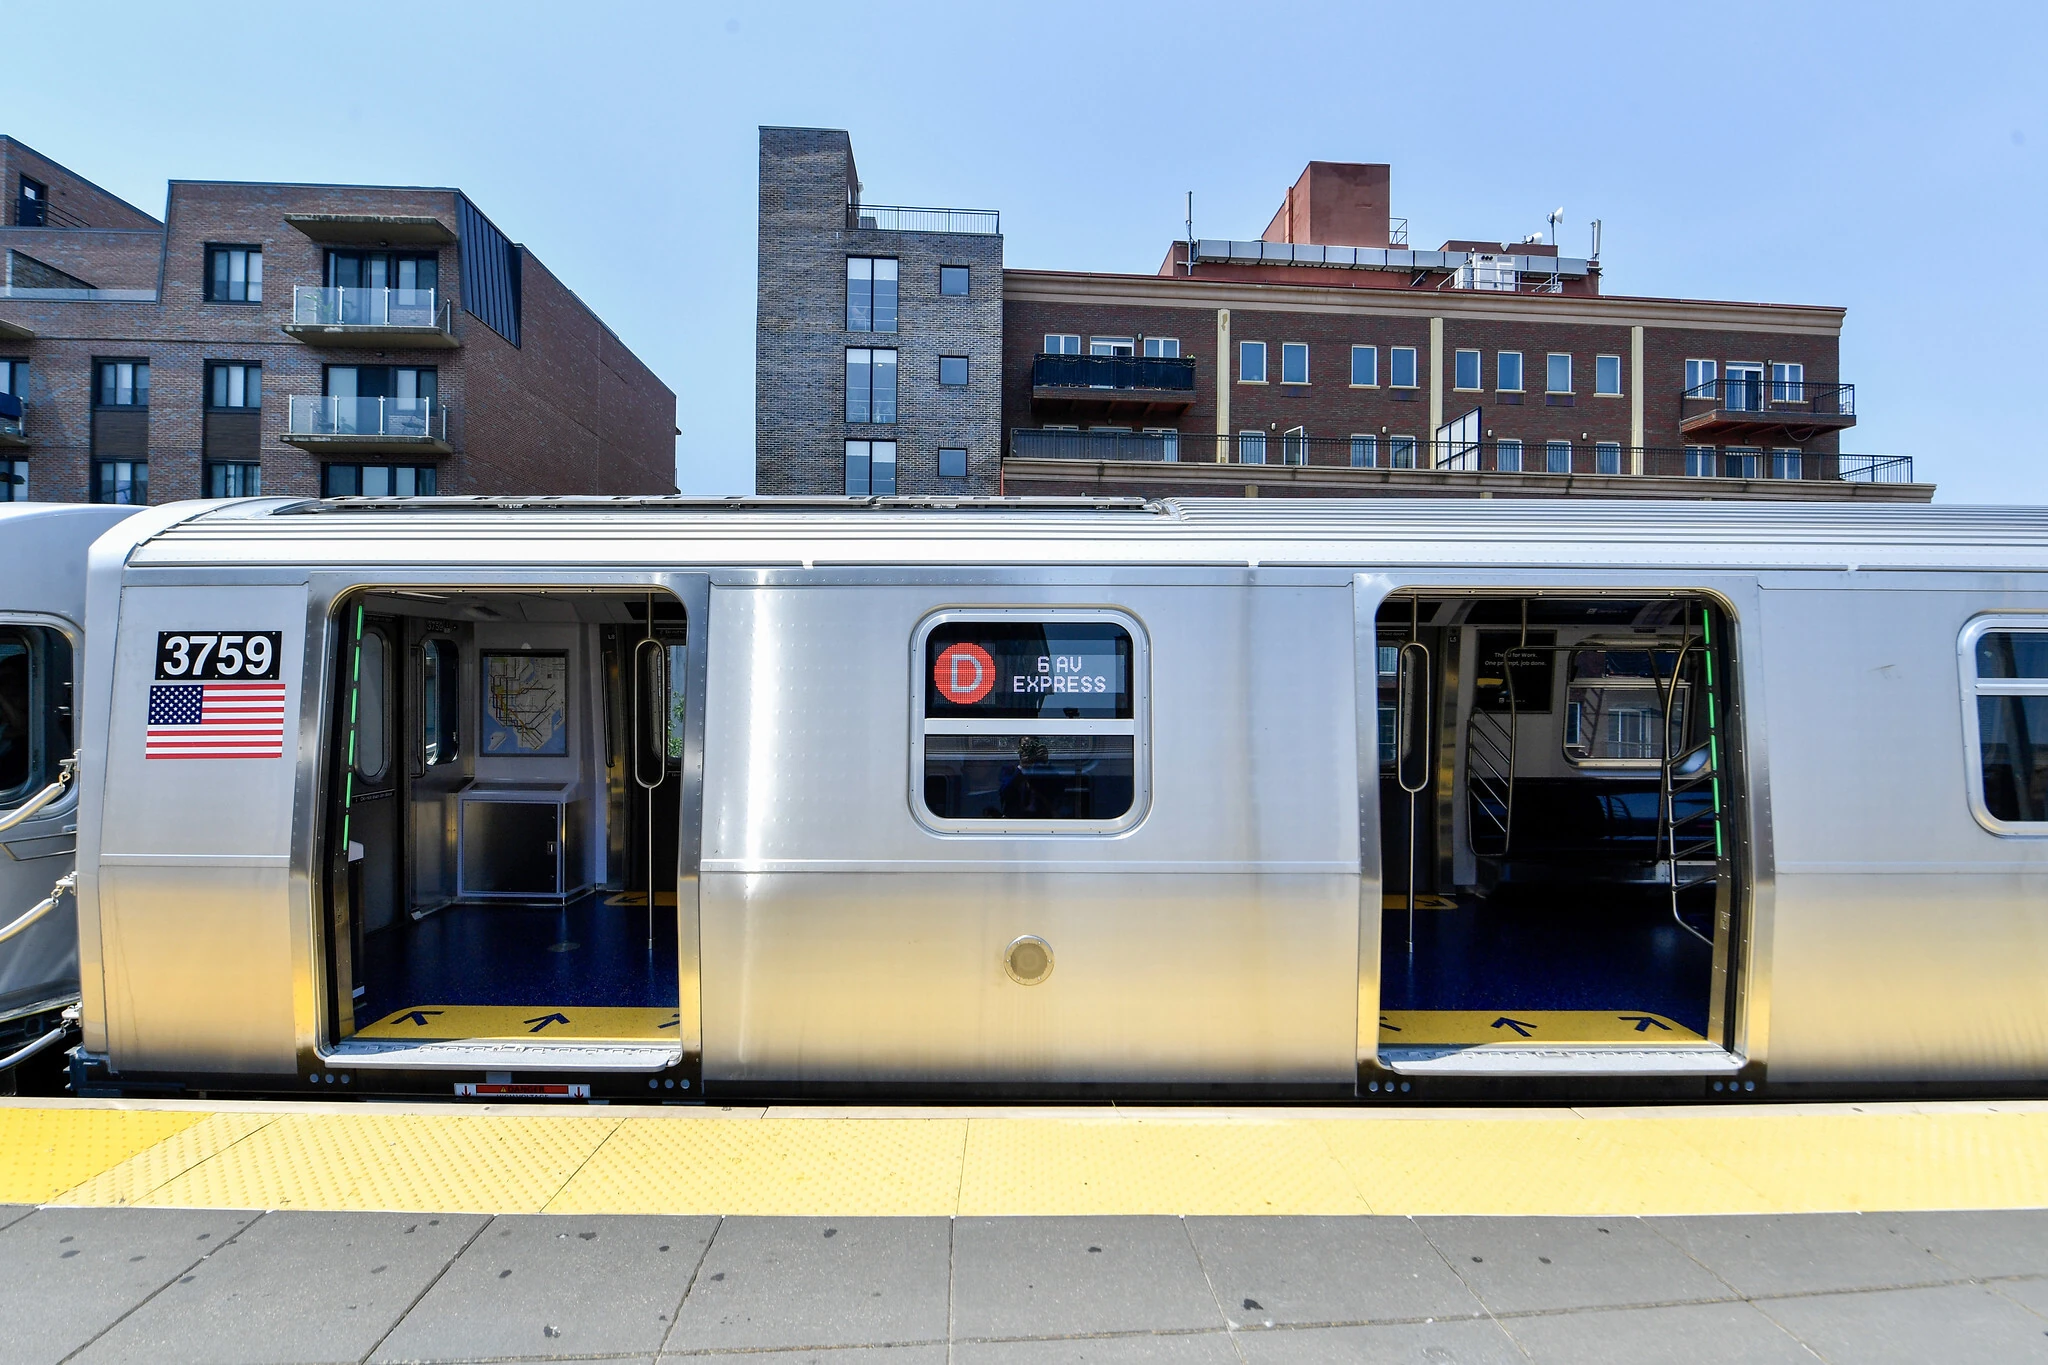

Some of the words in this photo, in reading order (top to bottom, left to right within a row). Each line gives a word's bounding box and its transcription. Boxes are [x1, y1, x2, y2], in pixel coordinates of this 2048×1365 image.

[163, 635, 273, 676] 3759
[1037, 655, 1050, 673] 6
[1056, 655, 1082, 673] AV
[1497, 660, 1520, 668] prmpt,
[1520, 660, 1530, 668] job
[951, 654, 983, 693] D
[1013, 675, 1107, 693] EXPRESS
[507, 1085, 545, 1093] DANGER
